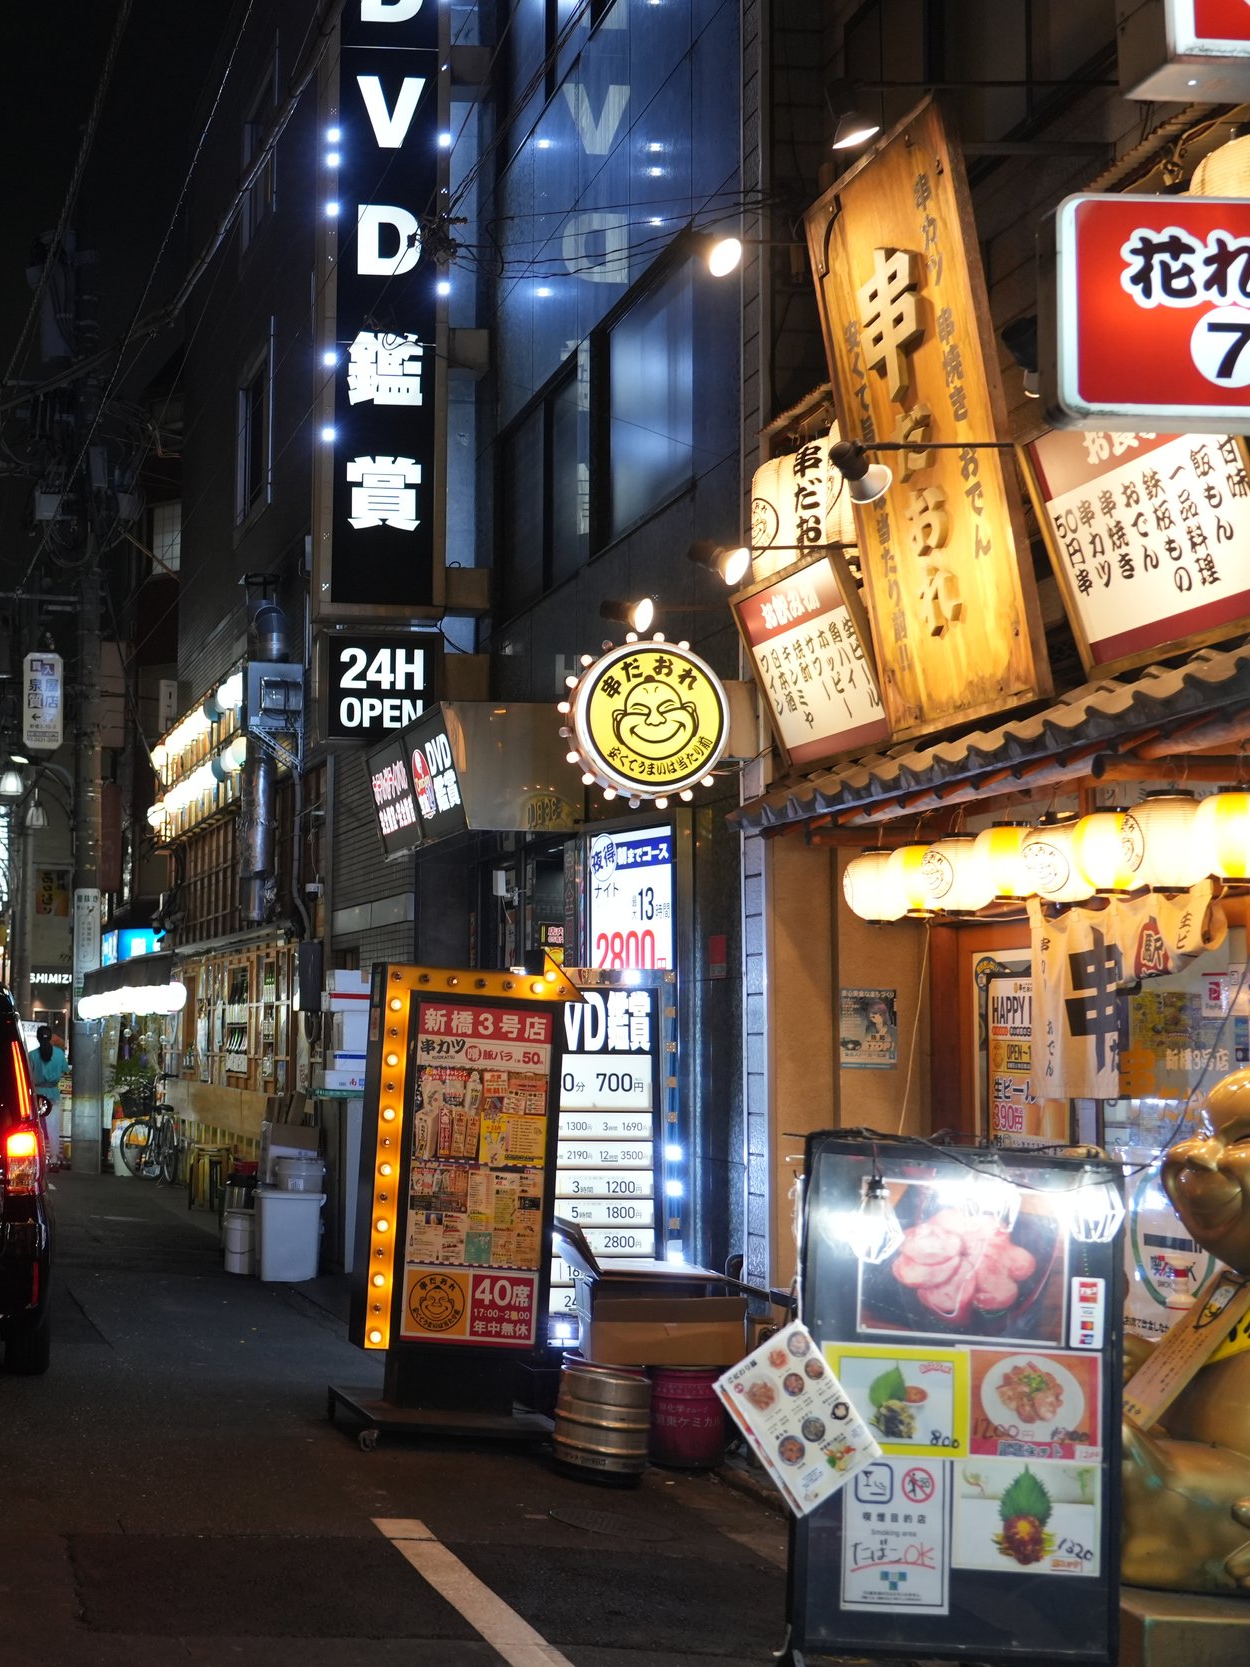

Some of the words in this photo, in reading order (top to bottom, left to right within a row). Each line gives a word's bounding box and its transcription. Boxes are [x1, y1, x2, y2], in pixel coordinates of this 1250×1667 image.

[913, 171, 944, 287] 串カツ
[935, 306, 969, 423] 串焼き
[1205, 321, 1250, 380] 7
[855, 246, 963, 638] 串だおれ
[958, 447, 992, 560] おでん
[1076, 499, 1113, 589] 串カツ
[1097, 489, 1136, 581] 串焼き
[1120, 480, 1161, 573] おでん
[1141, 467, 1194, 594] 鉄板もの
[1053, 508, 1094, 597] 50円串
[339, 648, 425, 691] 24H
[600, 655, 698, 699] 串だおれ
[759, 654, 785, 717] ワイン
[770, 648, 798, 713] 日本酒
[804, 634, 831, 701] サワー
[339, 698, 424, 729] OPEN
[424, 733, 453, 778] DVD
[606, 735, 714, 777] 安くてうまいは当たり前
[591, 842, 616, 875] 夜得
[594, 882, 619, 900] ナイト
[424, 1008, 548, 1041] 新橋3号店
[992, 996, 1025, 1025] HAPPY
[420, 1038, 467, 1056] 串カツ
[595, 1072, 644, 1093] 700円
[572, 1180, 594, 1194] 3時間
[605, 1180, 643, 1194] 1200円
[571, 1206, 593, 1219] 5時間
[606, 1206, 643, 1219] 1800円
[603, 1235, 643, 1249] 2800円
[474, 1278, 531, 1308] 40席
[473, 1320, 529, 1337] 年中無休
[929, 1430, 961, 1449] 800
[871, 1529, 900, 1539] Smoking
[901, 1530, 918, 1538] area
